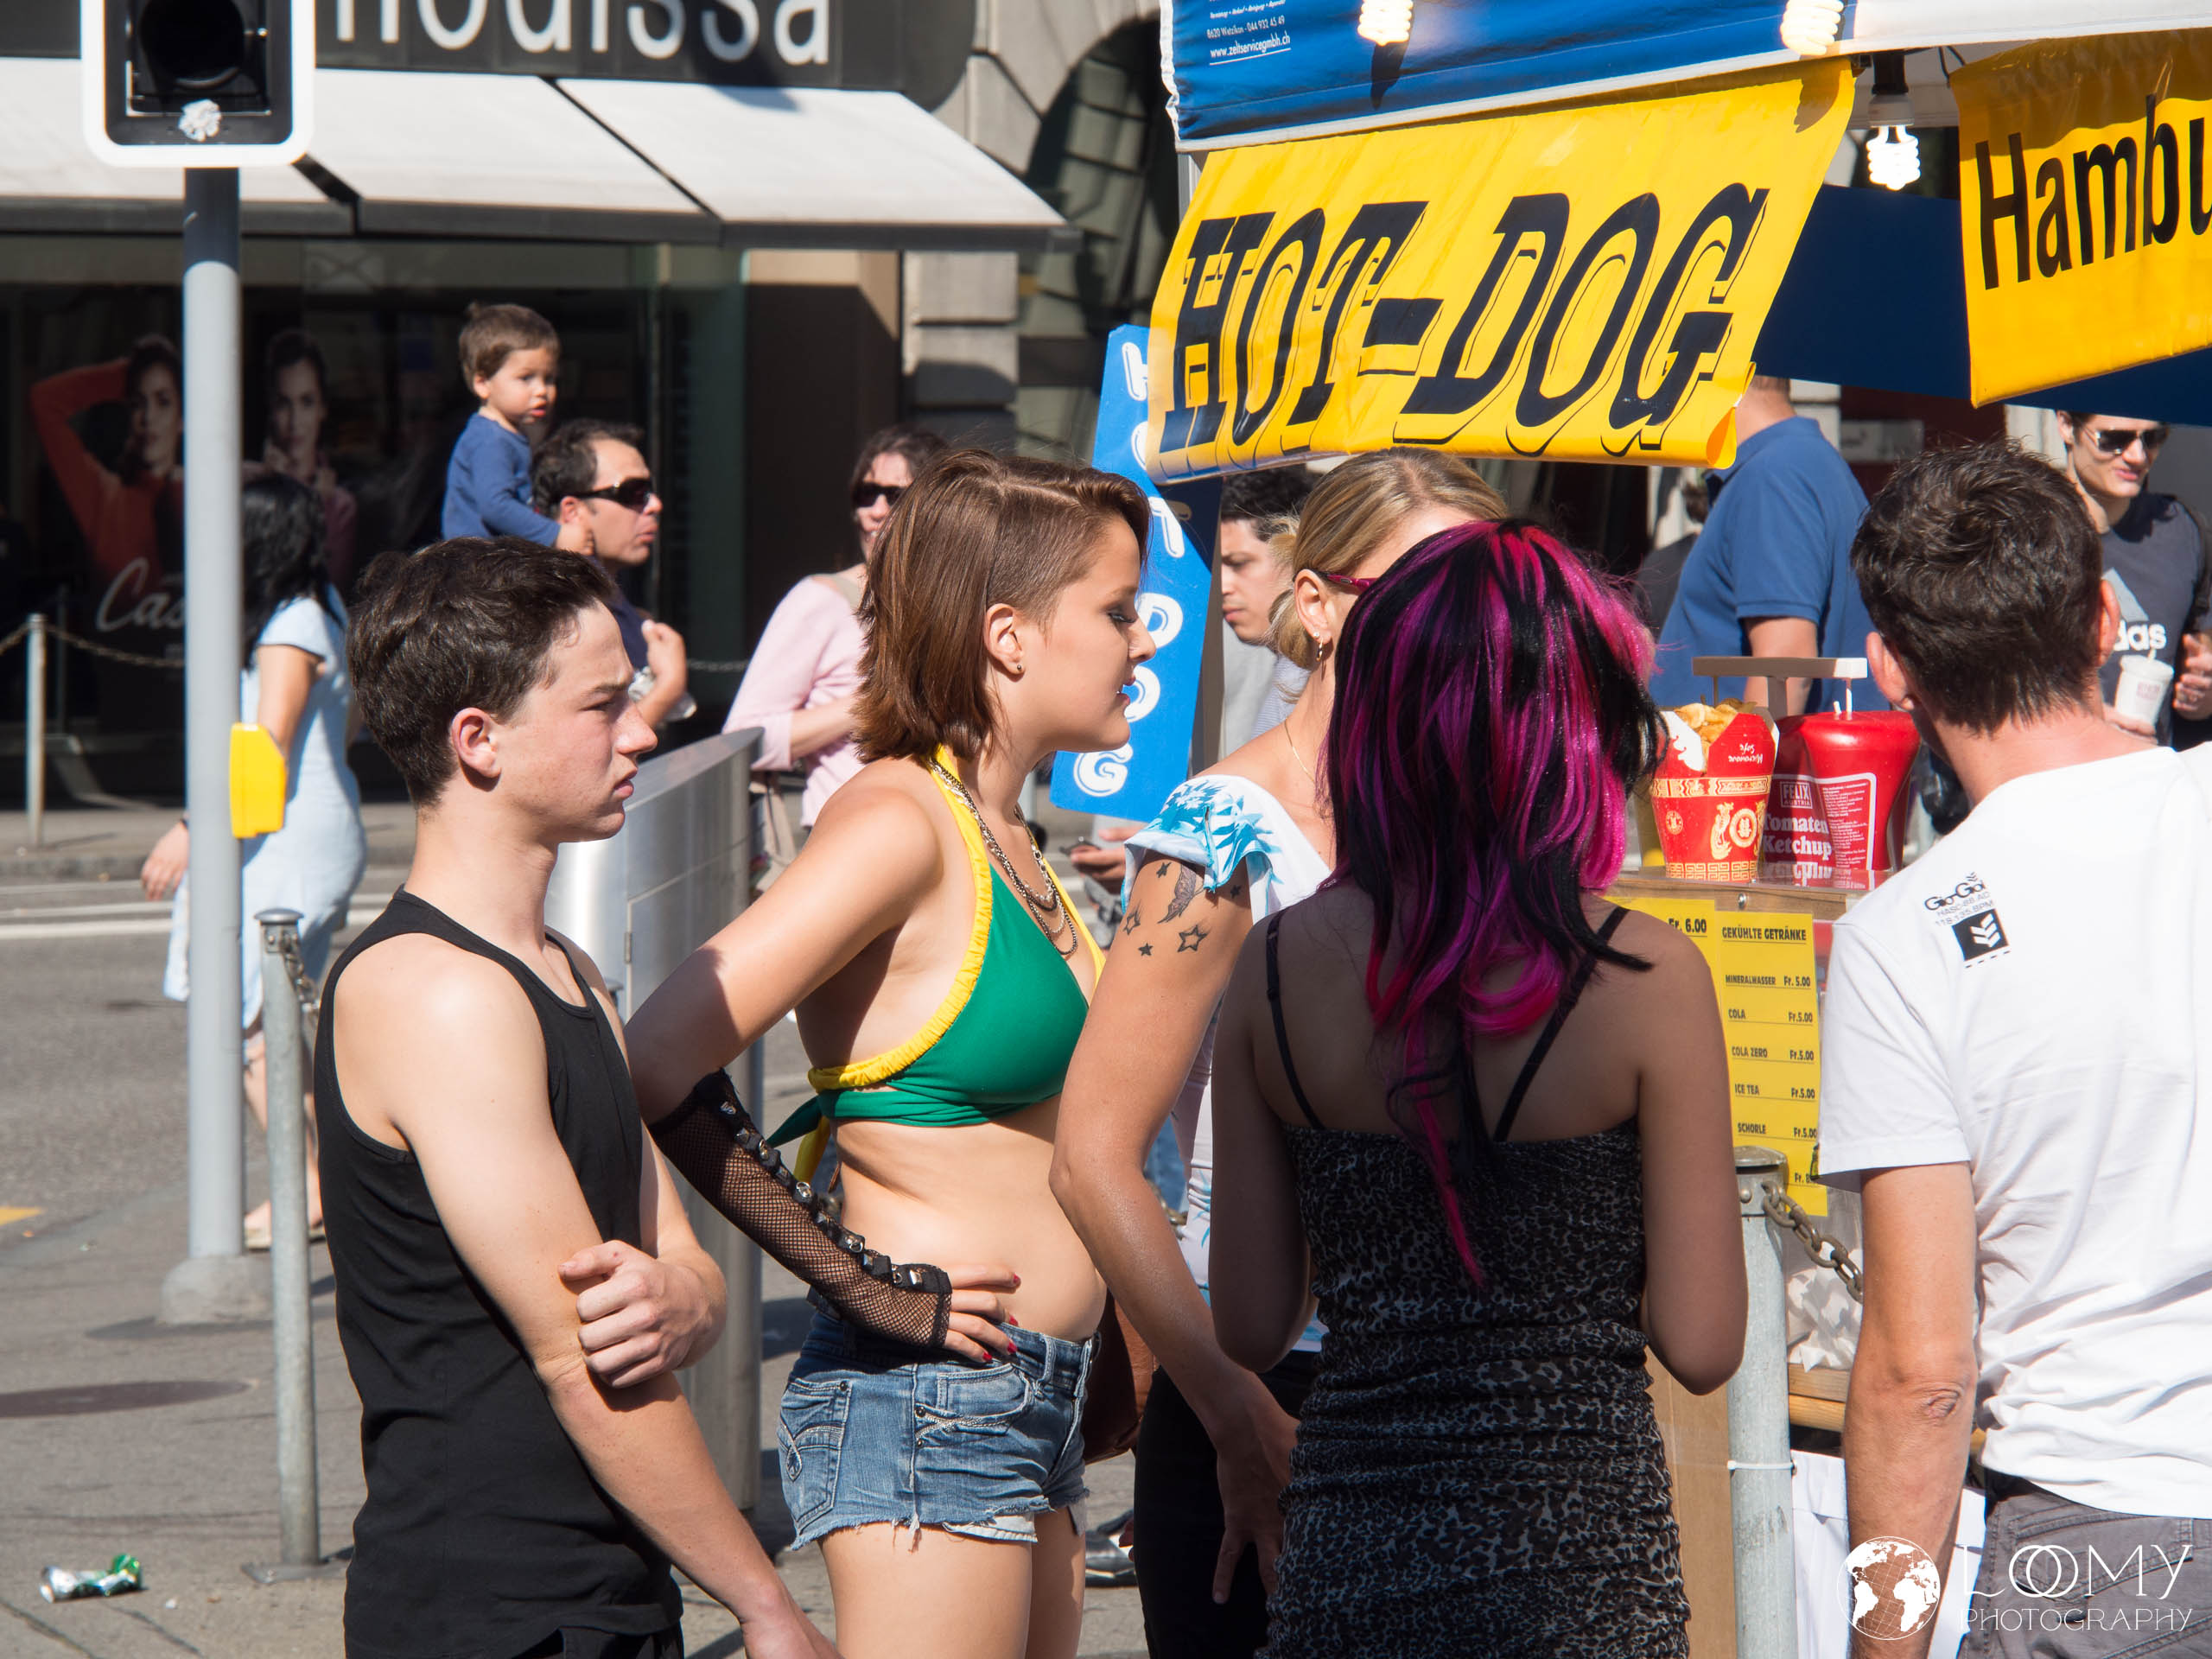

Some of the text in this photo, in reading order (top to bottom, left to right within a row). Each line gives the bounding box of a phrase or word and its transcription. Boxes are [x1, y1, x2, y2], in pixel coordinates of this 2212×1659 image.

[1210, 29, 1291, 58] www.zeltservicegmbh.ch
[1975, 93, 2212, 290] Hambu
[1158, 181, 1770, 462] HOT-DOG
[1783, 784, 1810, 799] FELIX
[1764, 813, 1829, 835] Tomaten
[1763, 835, 1833, 861] Ketchup
[1685, 918, 1707, 933] 6.00
[1722, 924, 1807, 941] GEKÜHLTE GETRÄNKE
[1725, 974, 1777, 985] MINERALWASSER
[1796, 976, 1811, 987] 5.00
[1728, 1008, 1746, 1020] COLA
[1732, 1046, 1749, 1057] COLA
[1751, 1047, 1768, 1058] ZERO
[1734, 1083, 1745, 1095] ICE
[1746, 1084, 1760, 1096] TEA
[1737, 1122, 1766, 1135] SCHORLE
